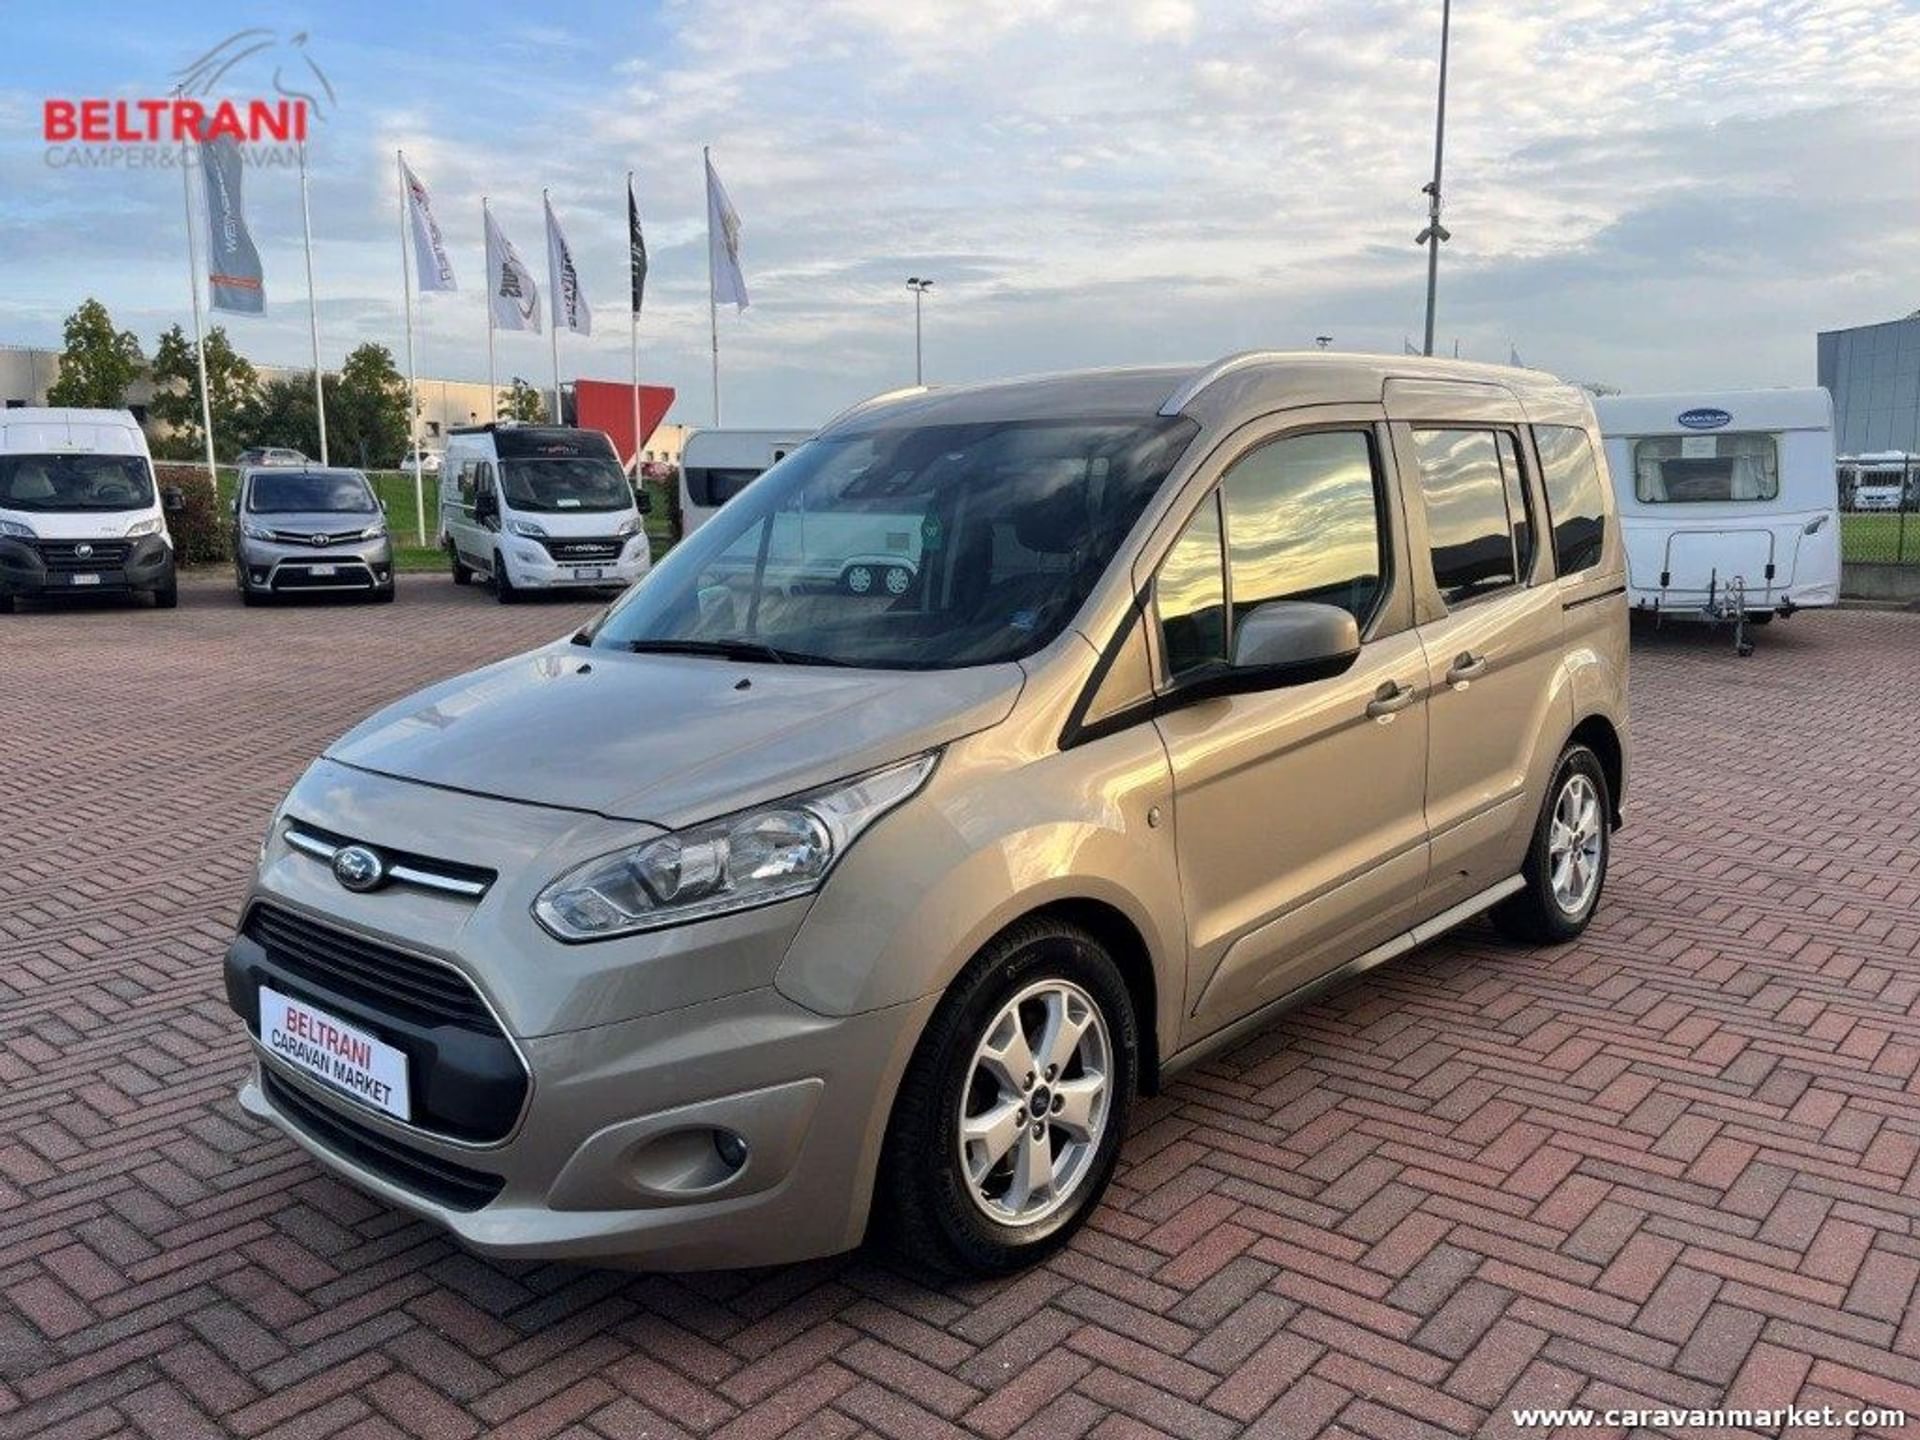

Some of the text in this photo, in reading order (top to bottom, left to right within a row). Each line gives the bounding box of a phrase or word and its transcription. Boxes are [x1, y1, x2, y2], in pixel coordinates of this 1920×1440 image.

[271, 1028, 392, 1106] CARAVAN MARKET
[286, 1006, 372, 1070] BELTRANI
